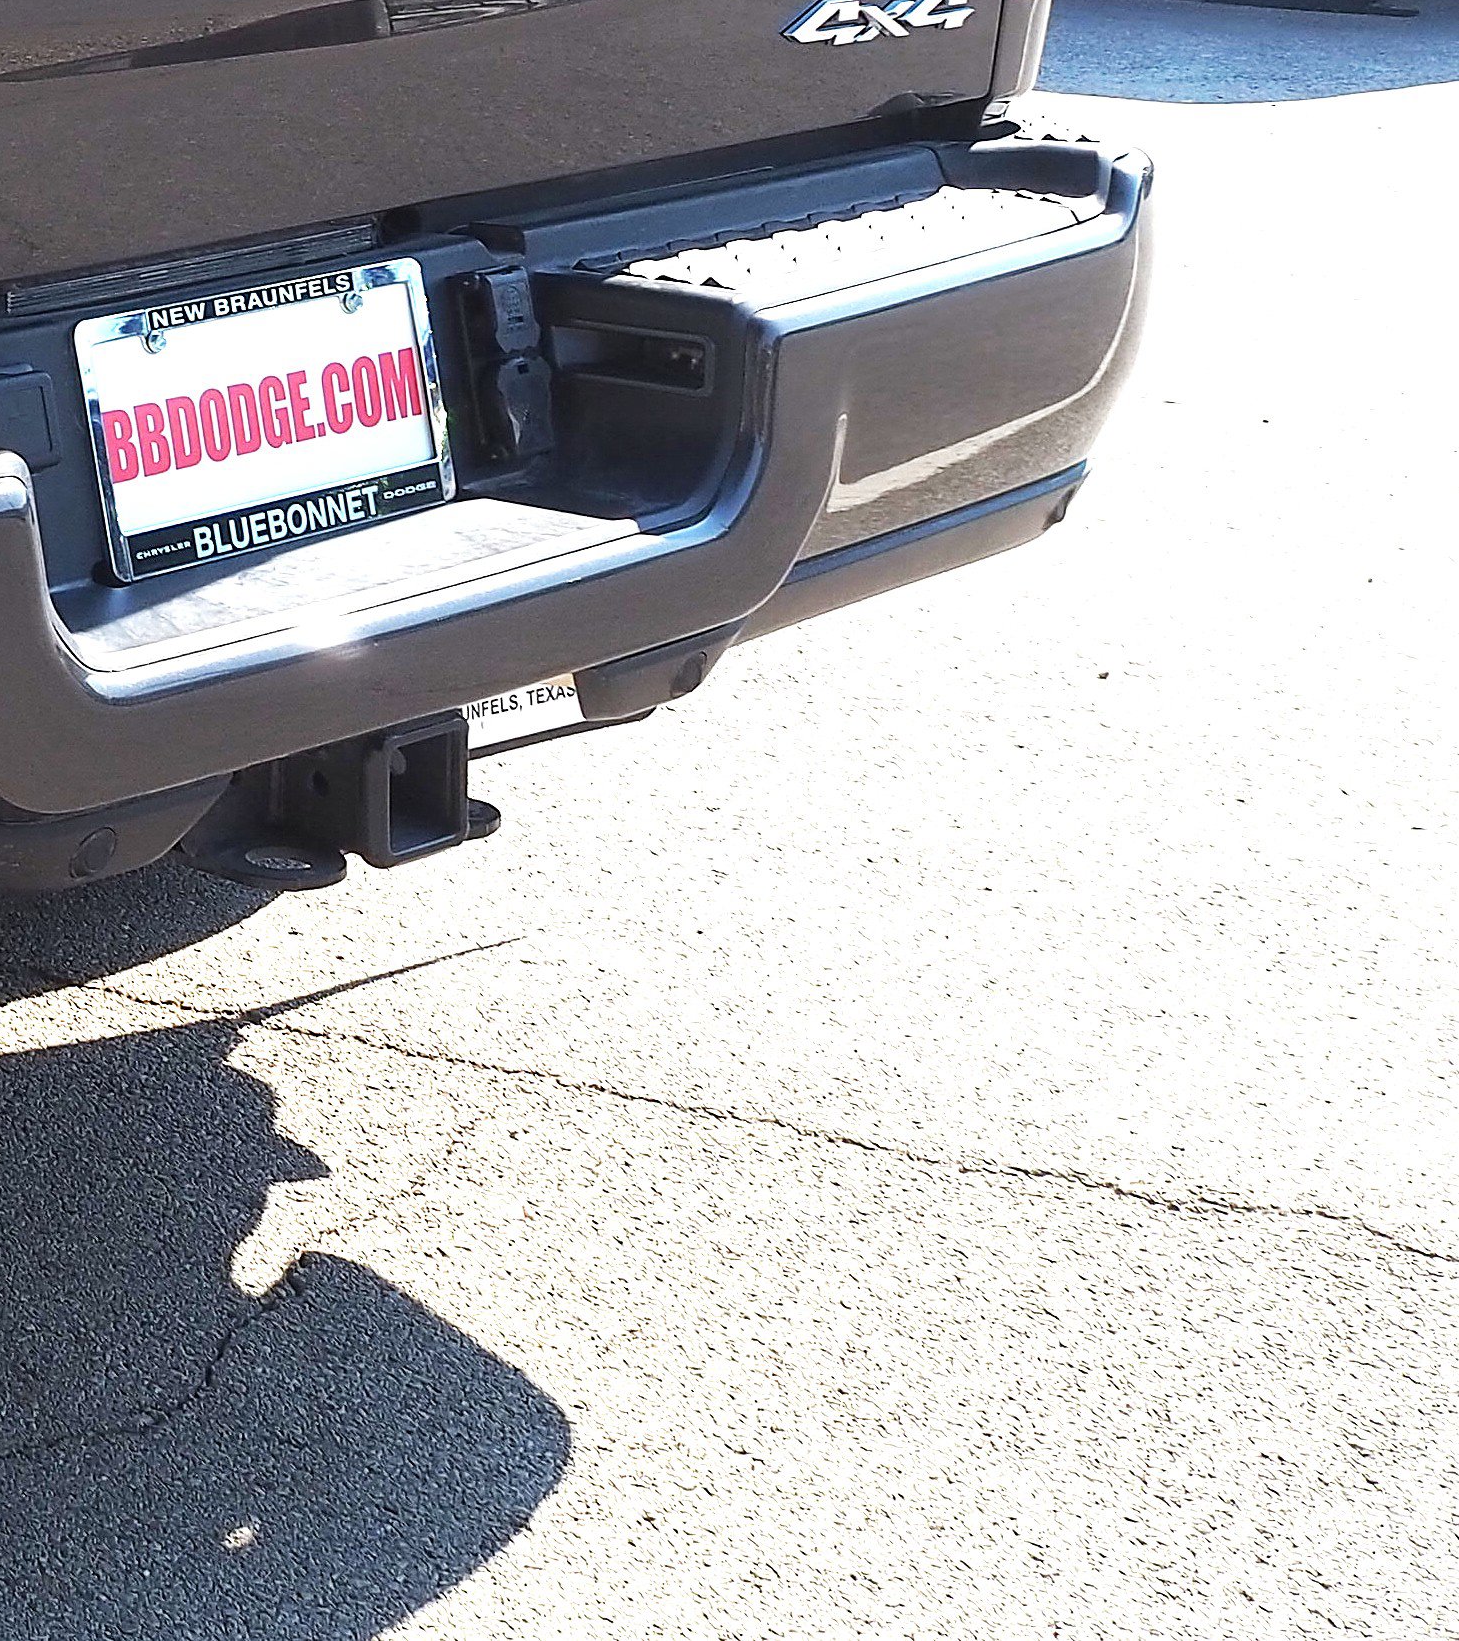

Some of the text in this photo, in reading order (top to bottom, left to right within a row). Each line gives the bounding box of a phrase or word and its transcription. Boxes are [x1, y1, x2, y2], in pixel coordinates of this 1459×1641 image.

[151, 273, 352, 329] NEW BRAUNFELS
[102, 347, 423, 484] BBDODGE.COM
[136, 480, 437, 560] CHRYSLER BLUEBONNET DODGE
